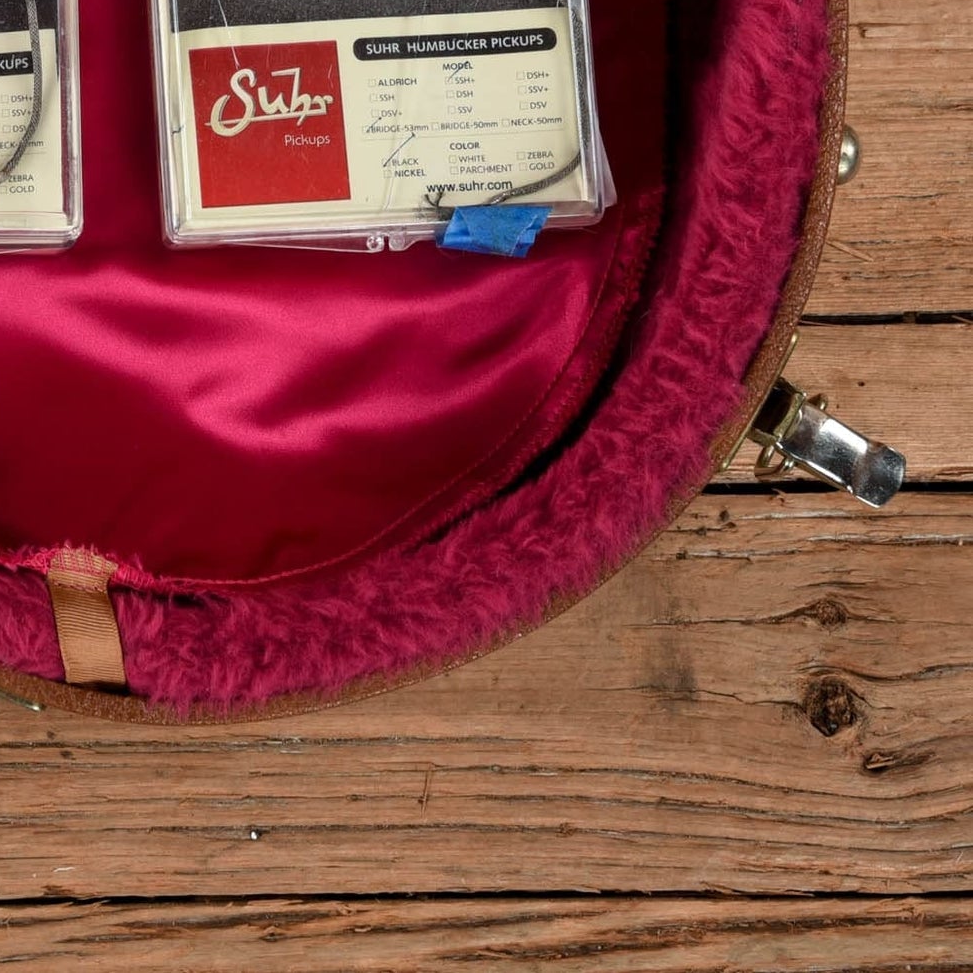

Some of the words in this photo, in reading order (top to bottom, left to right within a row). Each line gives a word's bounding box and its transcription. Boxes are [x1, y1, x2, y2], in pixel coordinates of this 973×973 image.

[366, 43, 400, 55] SUHR
[407, 39, 488, 53] HUMBUCKER
[491, 34, 544, 48] PICKUPS
[443, 62, 473, 71] MODEL
[455, 76, 475, 84] SSH+
[526, 71, 549, 80] DSH+
[378, 78, 417, 86] ALDRICH
[456, 90, 474, 98] DSH
[528, 85, 549, 94] SSV+
[379, 93, 395, 102] SSH
[204, 68, 334, 137] Suhr
[529, 101, 547, 110] DSV
[381, 109, 402, 118] DSV+
[457, 106, 473, 114] SSV
[441, 120, 499, 130] BRIDGE-50mm
[511, 116, 563, 126] NECK-50mm
[284, 134, 331, 147] Pickups
[450, 141, 480, 150] COLOR
[458, 154, 486, 163] WHITE
[527, 150, 554, 159] ZEBRA
[392, 157, 419, 166] BLACK
[529, 161, 555, 171] GOLD
[394, 169, 426, 177] NICKEL
[460, 164, 513, 174] PARCHMENT
[8, 174, 34, 183] ZEBRA
[10, 185, 35, 194] GOLD
[427, 179, 513, 193] www.suhr.com
